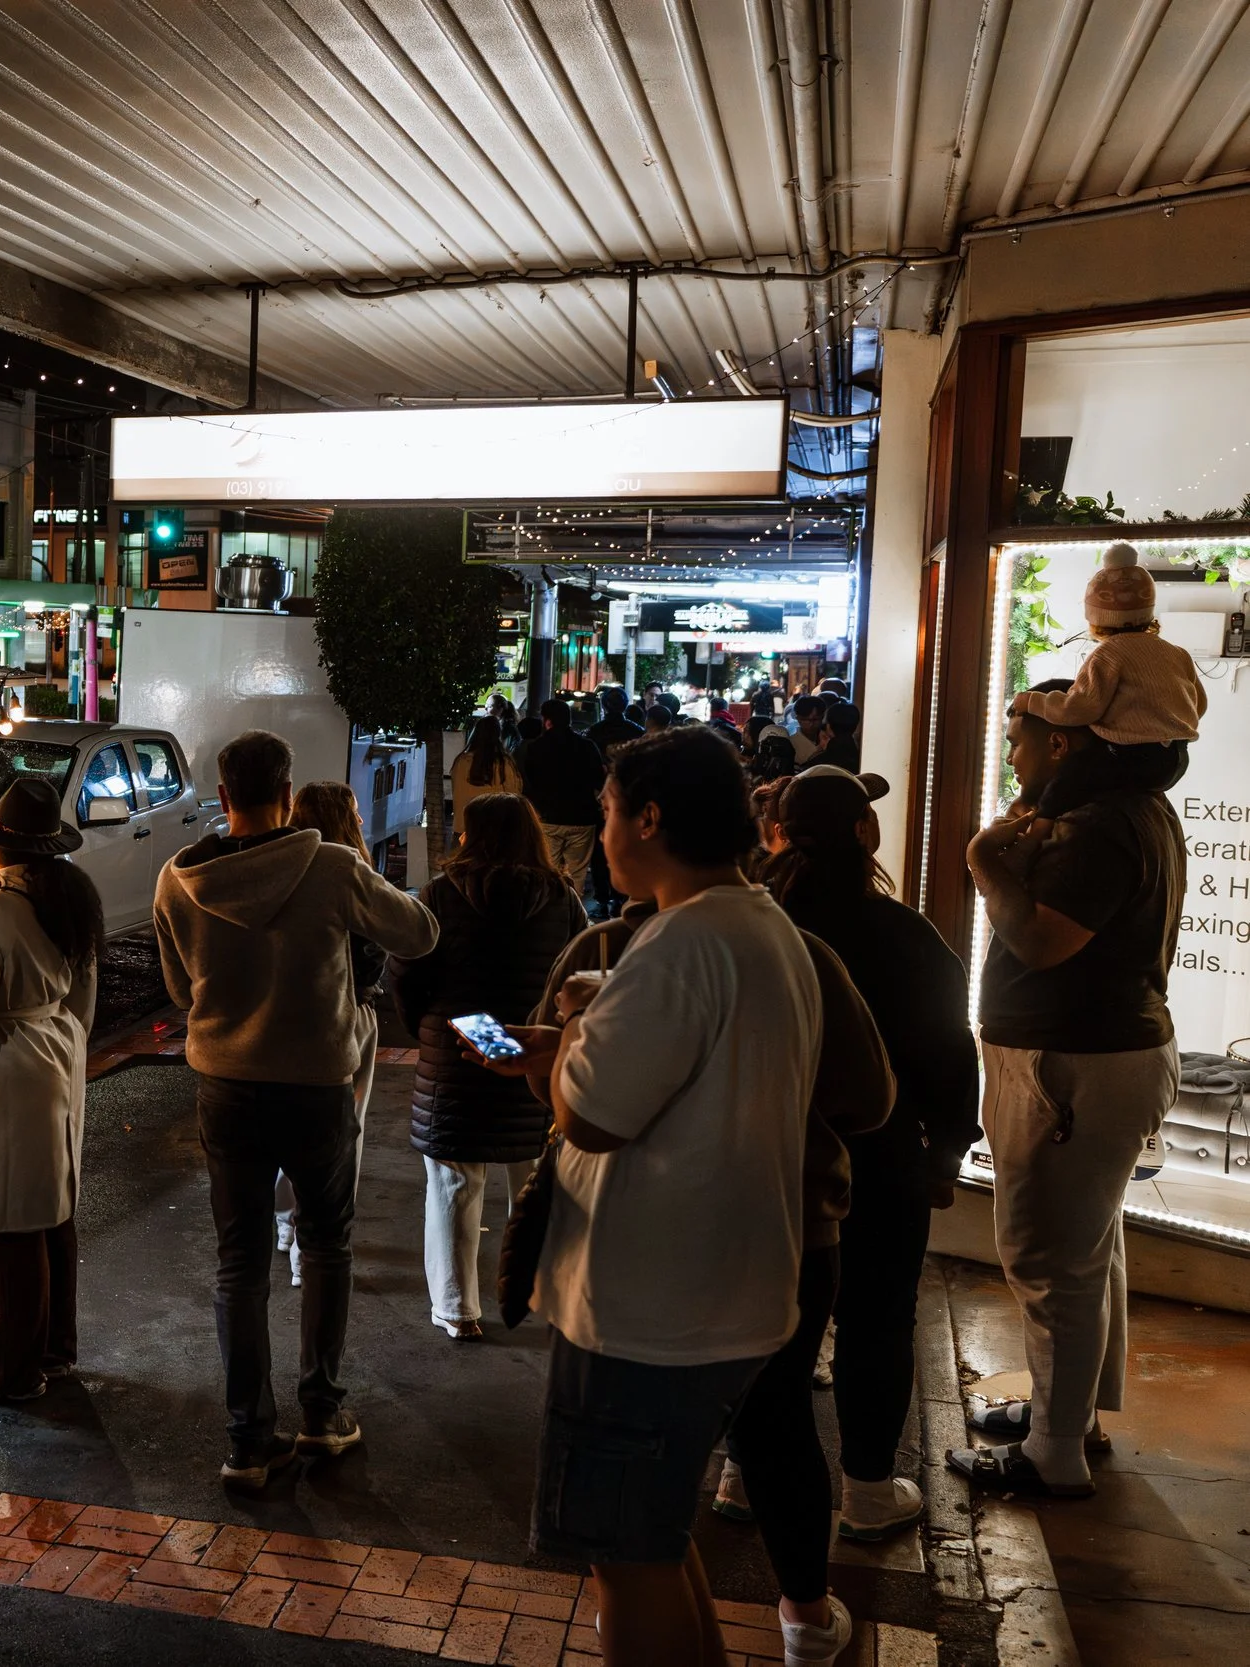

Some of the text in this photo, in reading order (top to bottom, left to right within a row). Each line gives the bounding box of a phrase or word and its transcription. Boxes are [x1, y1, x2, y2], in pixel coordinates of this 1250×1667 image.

[226, 481, 252, 497] (03)
[1184, 797, 1250, 823] Exter
[1185, 835, 1250, 861] erat
[1199, 874, 1218, 896] &
[1171, 946, 1246, 976] ials...
